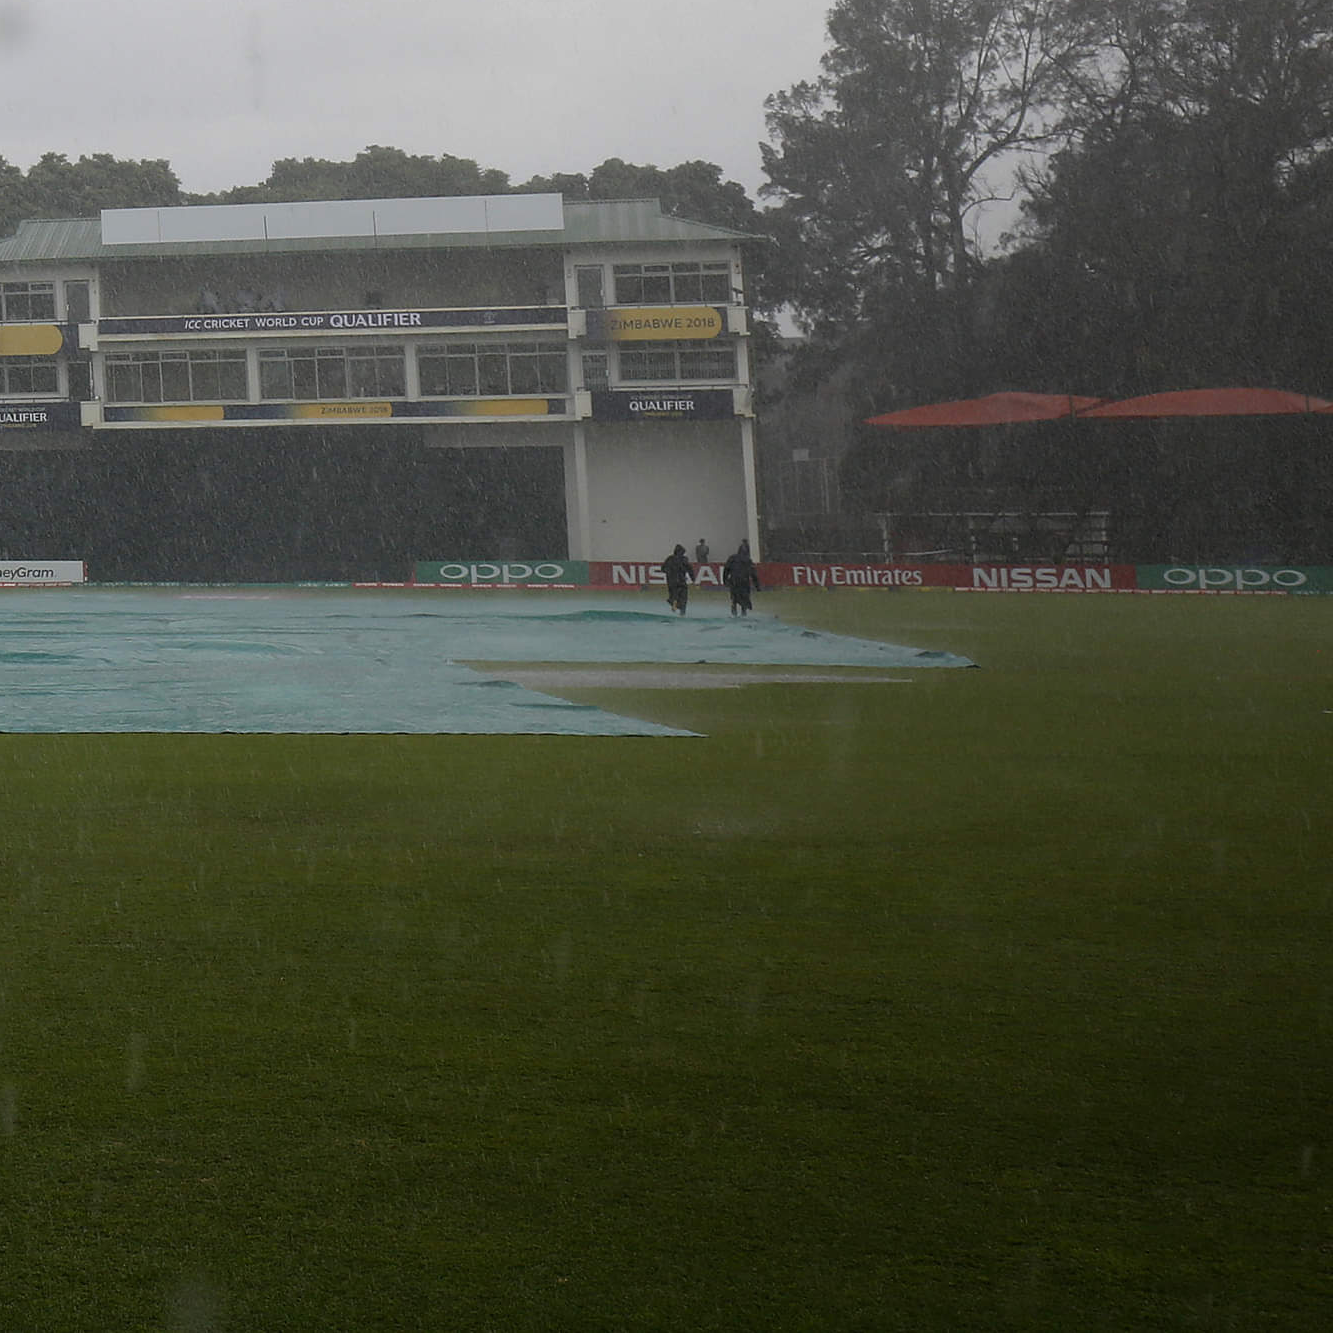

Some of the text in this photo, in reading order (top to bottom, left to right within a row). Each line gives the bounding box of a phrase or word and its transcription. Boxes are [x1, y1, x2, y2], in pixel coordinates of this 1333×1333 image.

[185, 312, 421, 330] ICC CRICKET WORLD CUP QUALIFIER
[611, 317, 715, 331] ZIMBABWE 2018
[629, 400, 694, 412] QUALIFIER
[439, 564, 564, 584] oppo
[792, 566, 923, 586] Fly Emirates
[973, 568, 1111, 588] NISSAN
[1163, 568, 1307, 589] oppo
